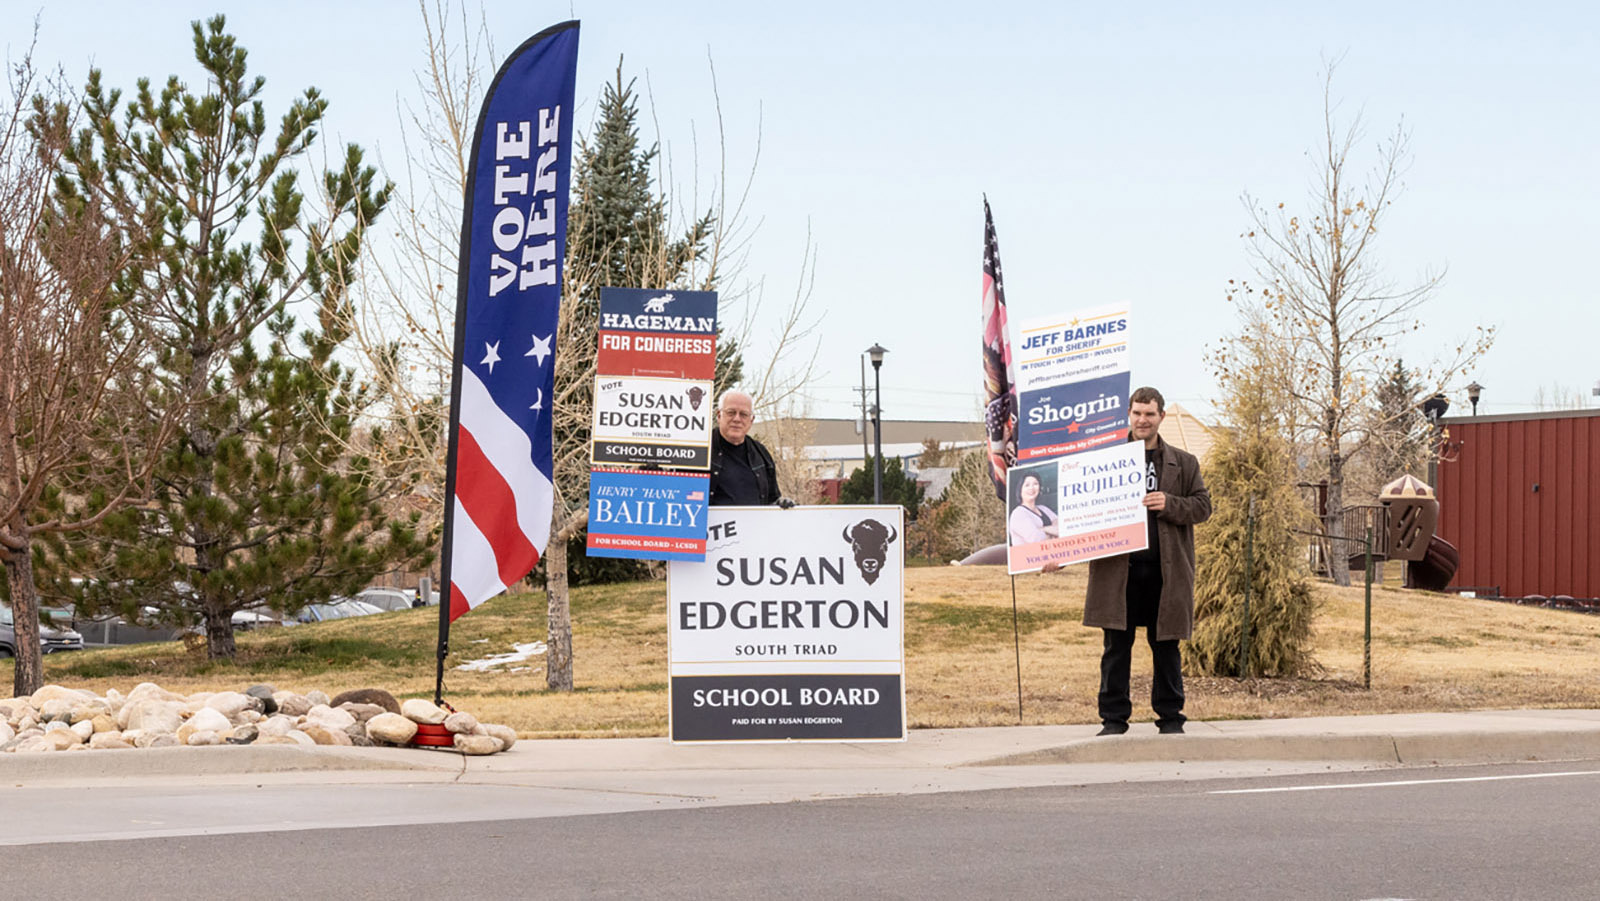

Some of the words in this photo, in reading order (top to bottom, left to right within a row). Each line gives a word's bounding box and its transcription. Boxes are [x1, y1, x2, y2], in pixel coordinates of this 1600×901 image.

[519, 104, 561, 292] HERE
[489, 121, 531, 297] VOTE
[602, 313, 714, 332] HAGEMAN
[602, 335, 631, 351] FOR
[634, 336, 712, 354] CONGRESS
[1021, 331, 1060, 350] JEFF
[1064, 319, 1127, 342] BARNES
[1046, 345, 1063, 356] FOR
[1065, 338, 1102, 352] SHERIFF
[1030, 360, 1051, 370] TOUCH
[1056, 353, 1089, 365] INFORMED
[1094, 345, 1127, 357] INVOLVED
[601, 381, 623, 391] VOTE
[618, 392, 683, 410] SUSAN
[1028, 393, 1121, 425] Shogrin
[599, 411, 705, 431] EDGERTON
[605, 445, 653, 457] SCHOOL
[656, 447, 696, 459] BOARD
[1080, 458, 1136, 477] TAMARA
[597, 485, 638, 497] HENRY
[1060, 471, 1142, 497] TRUJILLO
[595, 498, 703, 527] BAILEY
[1061, 502, 1088, 512] HOUSE
[1091, 494, 1127, 506] DISTRICT
[1050, 551, 1071, 559] VOTE
[1106, 539, 1129, 548] VOICE
[716, 556, 844, 586] SUSAN
[679, 600, 888, 630] EDGERTON
[735, 645, 787, 656] SOUTH
[793, 644, 838, 655] TRIAD
[693, 688, 792, 708] SCHOOL
[800, 687, 880, 706] BOARD
[779, 717, 803, 725] SUSAN
[804, 717, 843, 725] EDGERTON
